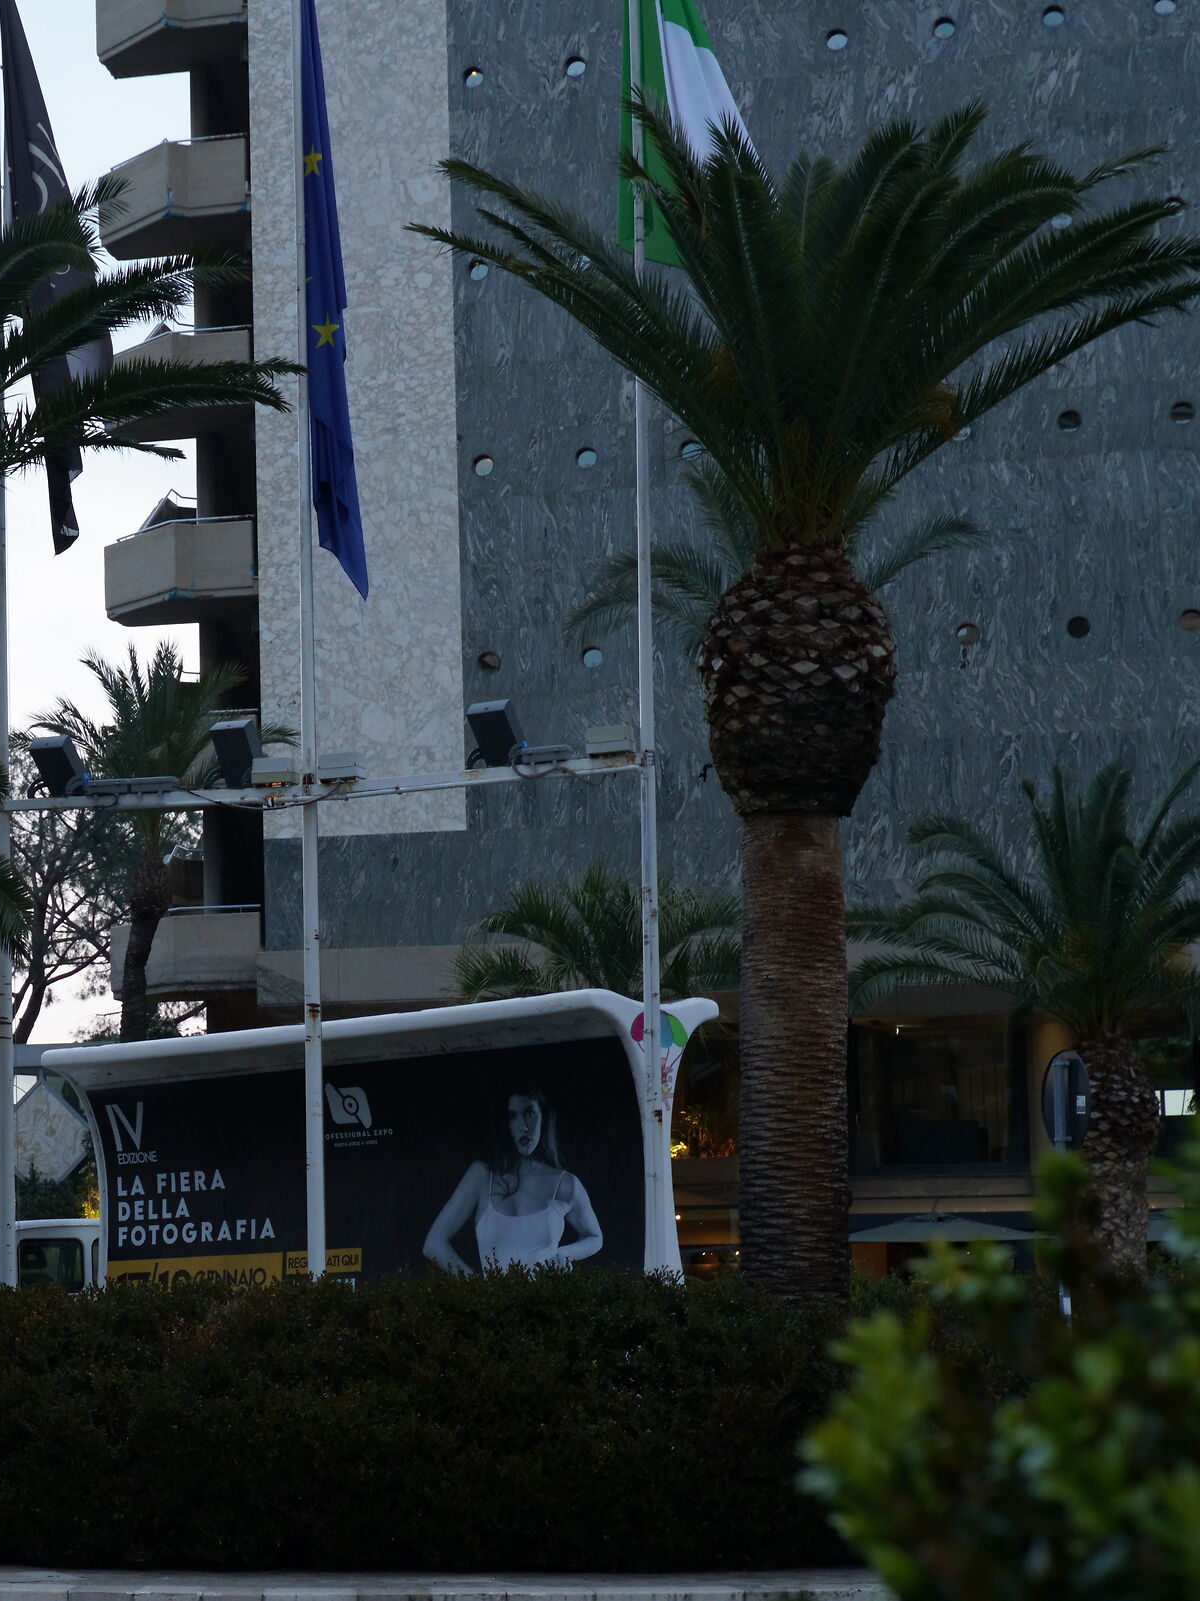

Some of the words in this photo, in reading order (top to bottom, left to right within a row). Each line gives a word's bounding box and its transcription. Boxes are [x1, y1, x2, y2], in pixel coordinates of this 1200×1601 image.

[105, 1101, 144, 1152] IV
[325, 1130, 371, 1140] OFESSIONAL
[373, 1128, 393, 1137] EXPO
[117, 1151, 158, 1165] EDIZIONE
[116, 1175, 145, 1197] LA
[156, 1168, 226, 1194] FIERA
[118, 1197, 191, 1222] DELLA
[118, 1217, 276, 1247] FOTOGRAFIA
[341, 1254, 359, 1266] QUI
